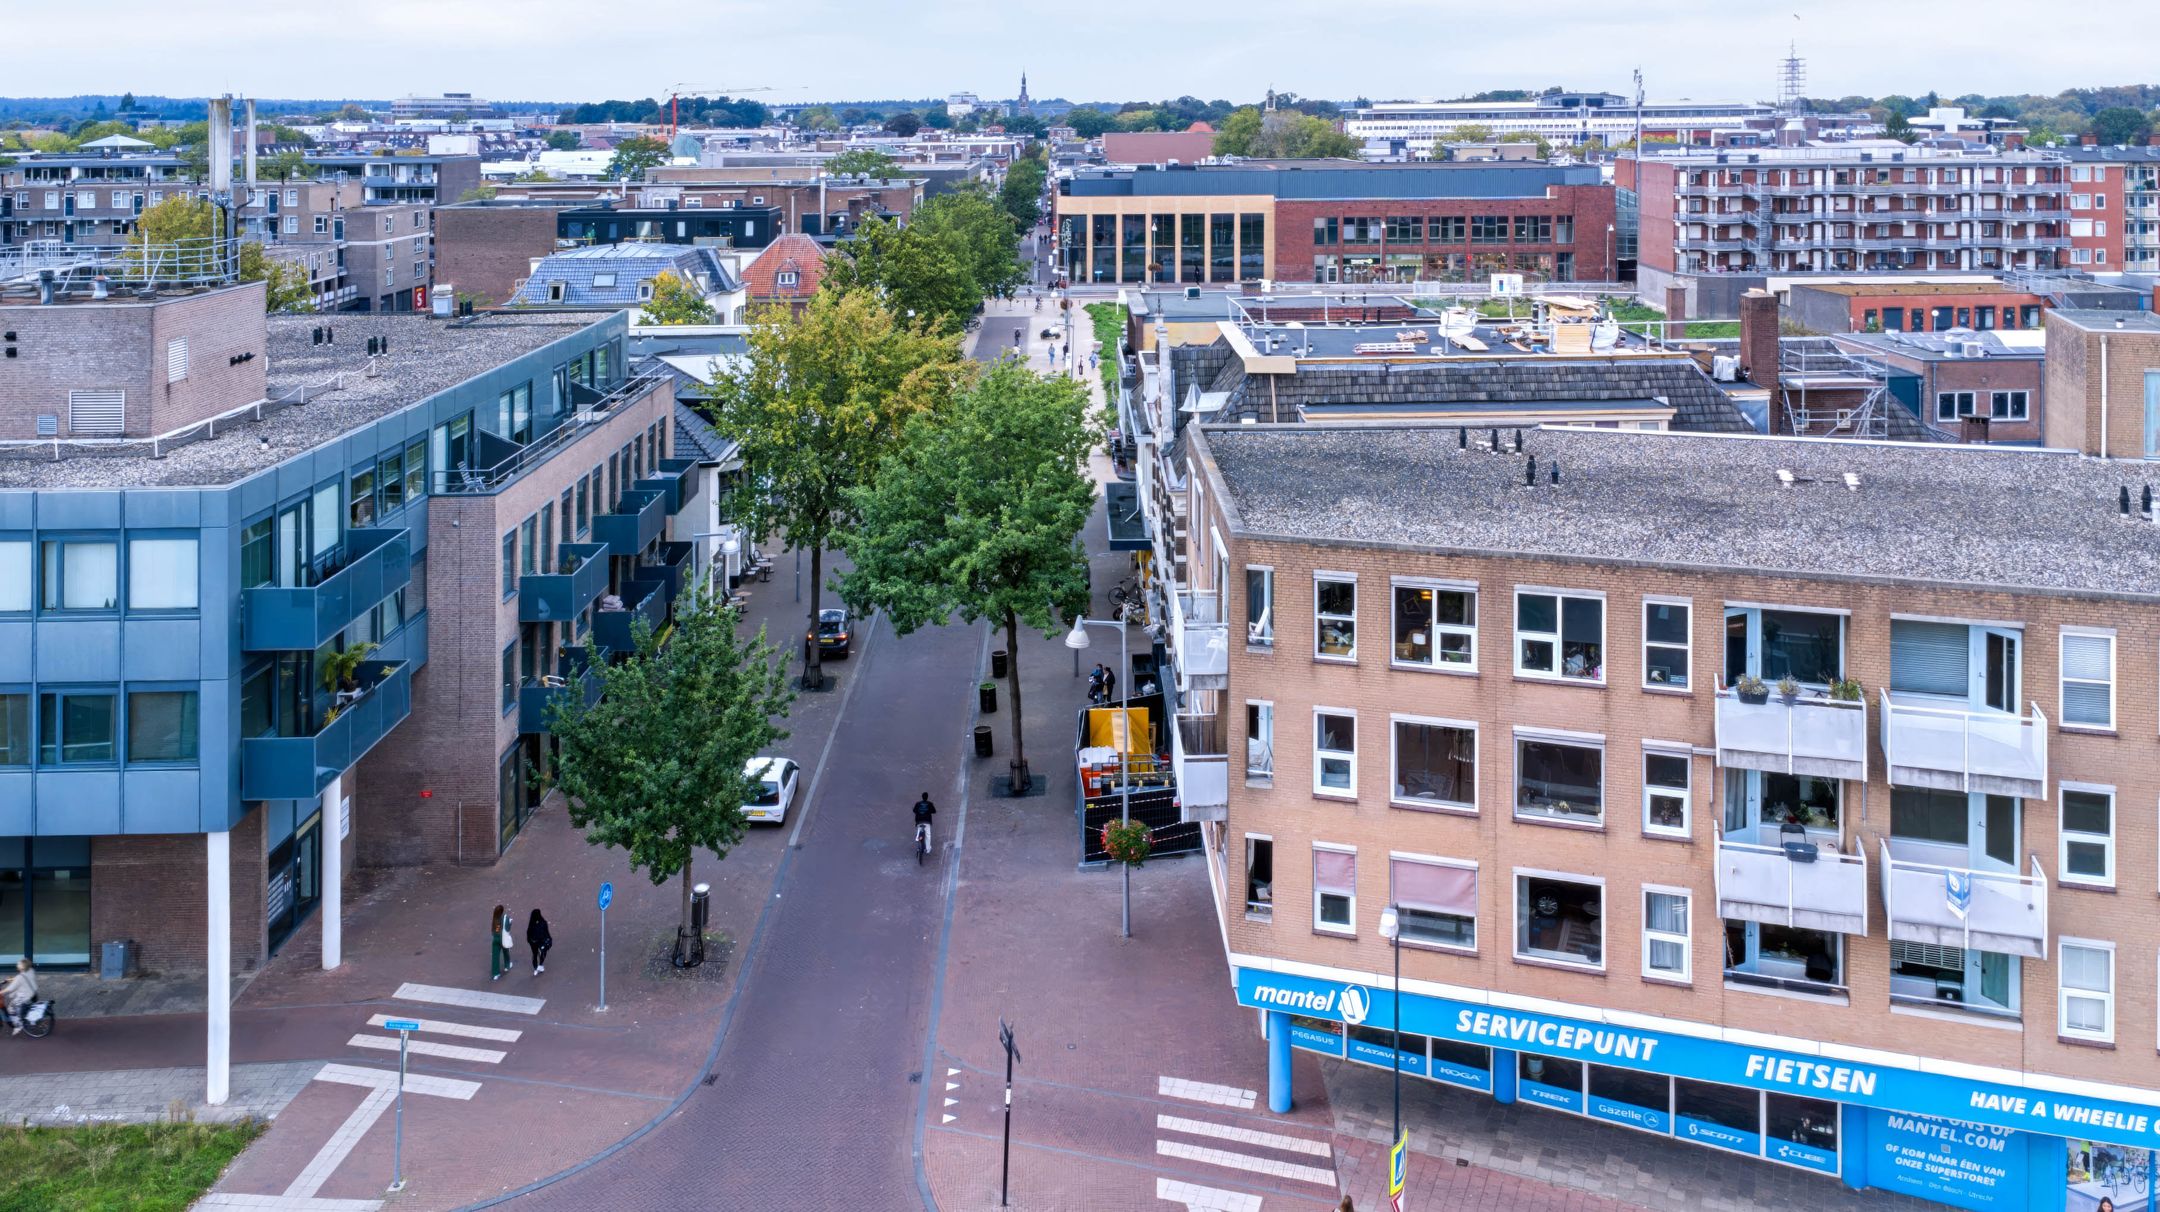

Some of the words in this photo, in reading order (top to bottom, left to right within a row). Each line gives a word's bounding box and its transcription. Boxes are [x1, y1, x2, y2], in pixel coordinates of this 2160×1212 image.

[1254, 985, 1336, 1012] mantel
[1292, 1030, 1335, 1046] PEGASUS
[1456, 1010, 1658, 1062] SERVICEPUNT
[1440, 1067, 1480, 1081] KOGA
[1745, 1054, 1877, 1096] FIETSEN
[1531, 1089, 1570, 1103] TREK
[1598, 1103, 1642, 1121] Gazelle
[1970, 1091, 2028, 1114] HAVE
[2031, 1101, 2047, 1117] A
[2053, 1103, 2148, 1133] WHEELIE
[1698, 1127, 1744, 1143] SCOTT
[1888, 1115, 2006, 1152] MANTEL.COM
[1788, 1149, 1826, 1164] CUBE
[1886, 1143, 1900, 1153] OF
[1901, 1147, 1926, 1160] KOM
[1928, 1152, 1958, 1168] NAAR
[1983, 1164, 2006, 1178] VAN
[1895, 1156, 1923, 1170] ONZE
[1924, 1163, 1996, 1187] SUPERSTORES
